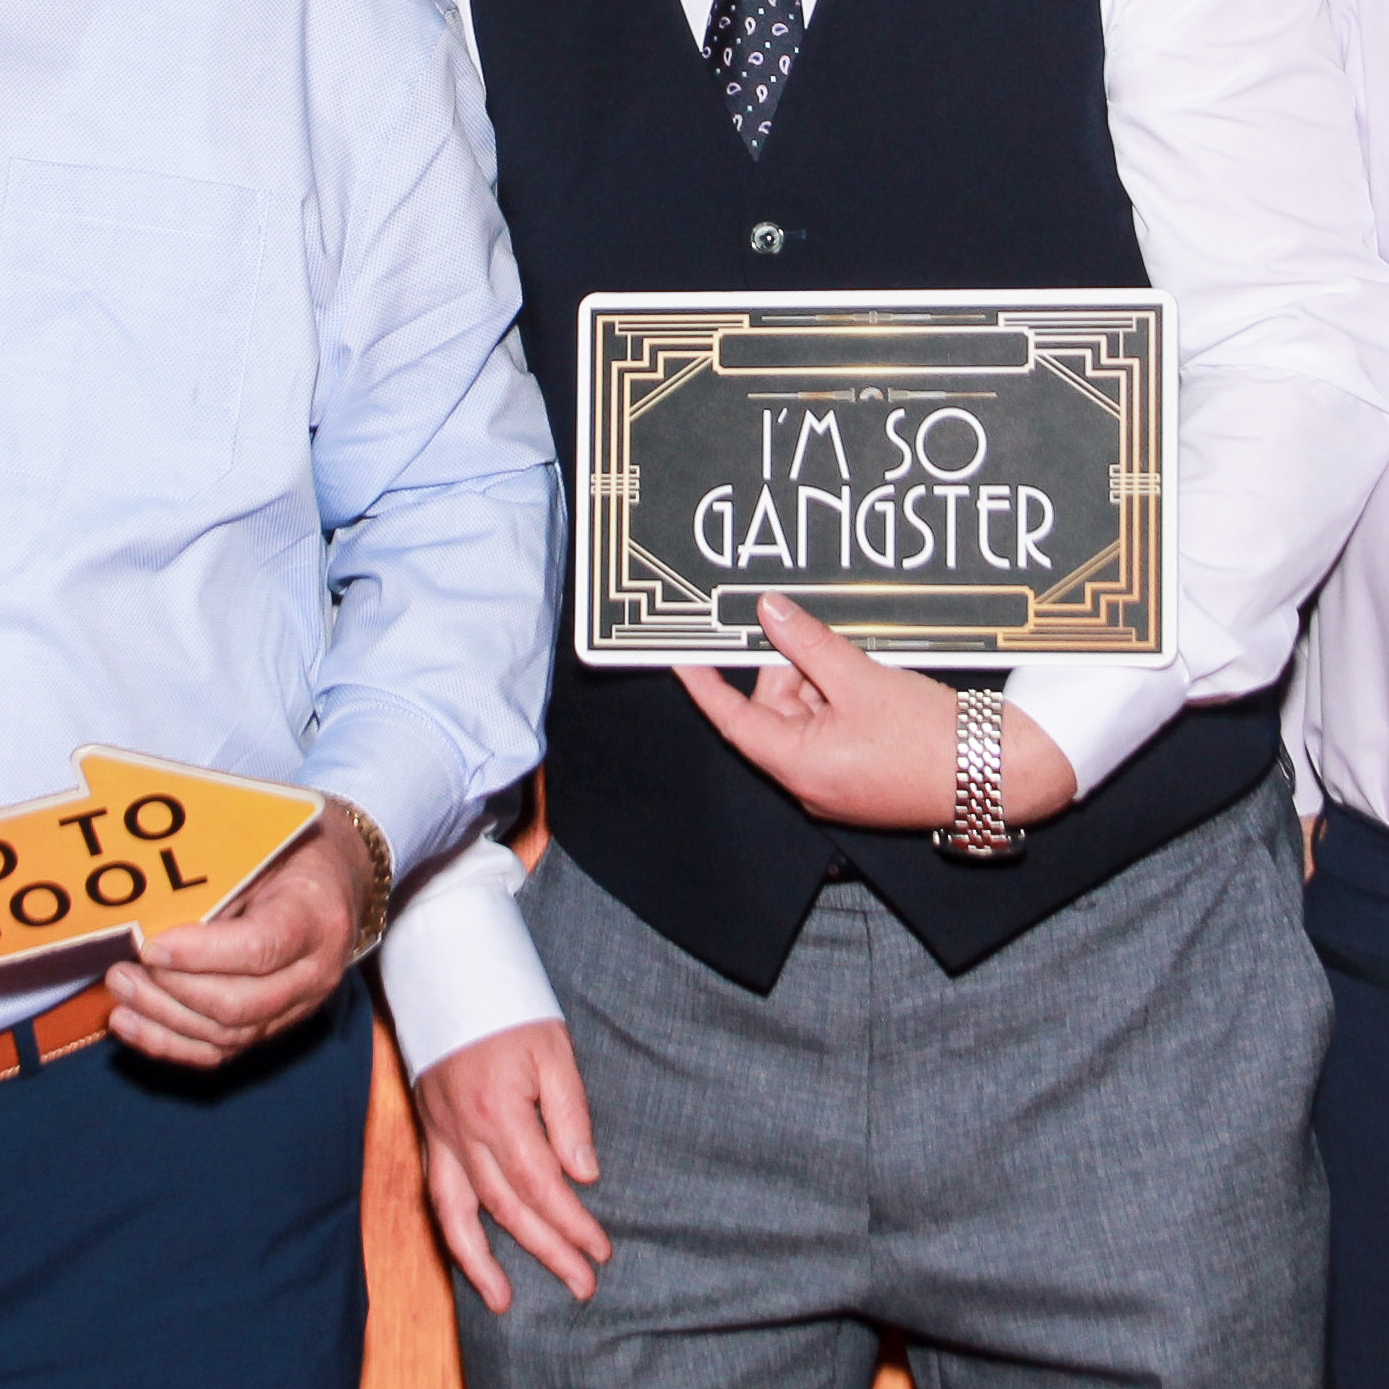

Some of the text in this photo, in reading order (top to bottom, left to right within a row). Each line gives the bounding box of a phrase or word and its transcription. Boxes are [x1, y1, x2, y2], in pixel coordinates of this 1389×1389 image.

[762, 406, 988, 482] I'M SO
[693, 483, 1056, 571] GANGSTER
[58, 792, 187, 858] TO
